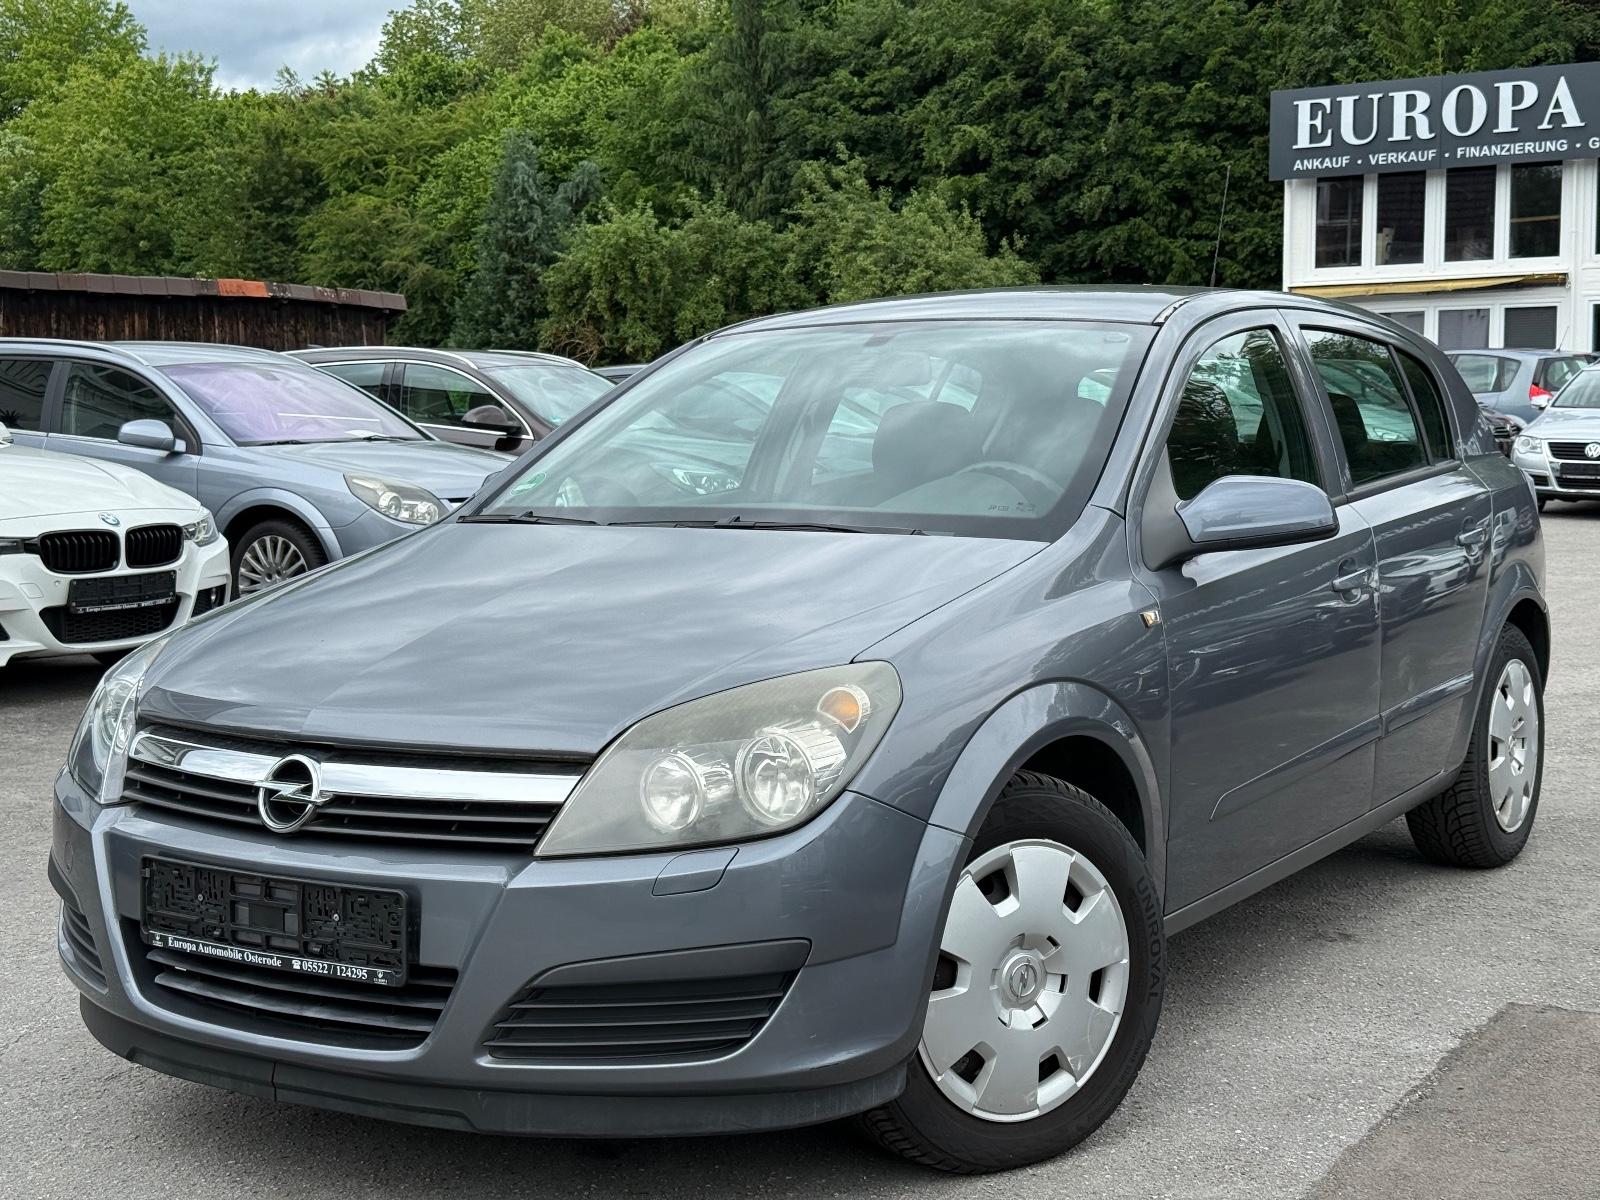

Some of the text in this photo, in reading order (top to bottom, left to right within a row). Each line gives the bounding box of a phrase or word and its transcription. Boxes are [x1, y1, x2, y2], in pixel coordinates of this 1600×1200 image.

[1292, 76, 1586, 149] EUROPA
[1293, 156, 1351, 171] ANKAUF
[1369, 150, 1437, 165] VERKAUF
[1456, 139, 1568, 158] FINANZIERUNG
[168, 936, 196, 953] Europa
[198, 943, 243, 960] Automobile
[244, 952, 282, 967] Osterode
[302, 960, 328, 974] 05522
[336, 965, 368, 980] 124295
[1136, 875, 1162, 998] UNIROYAL
